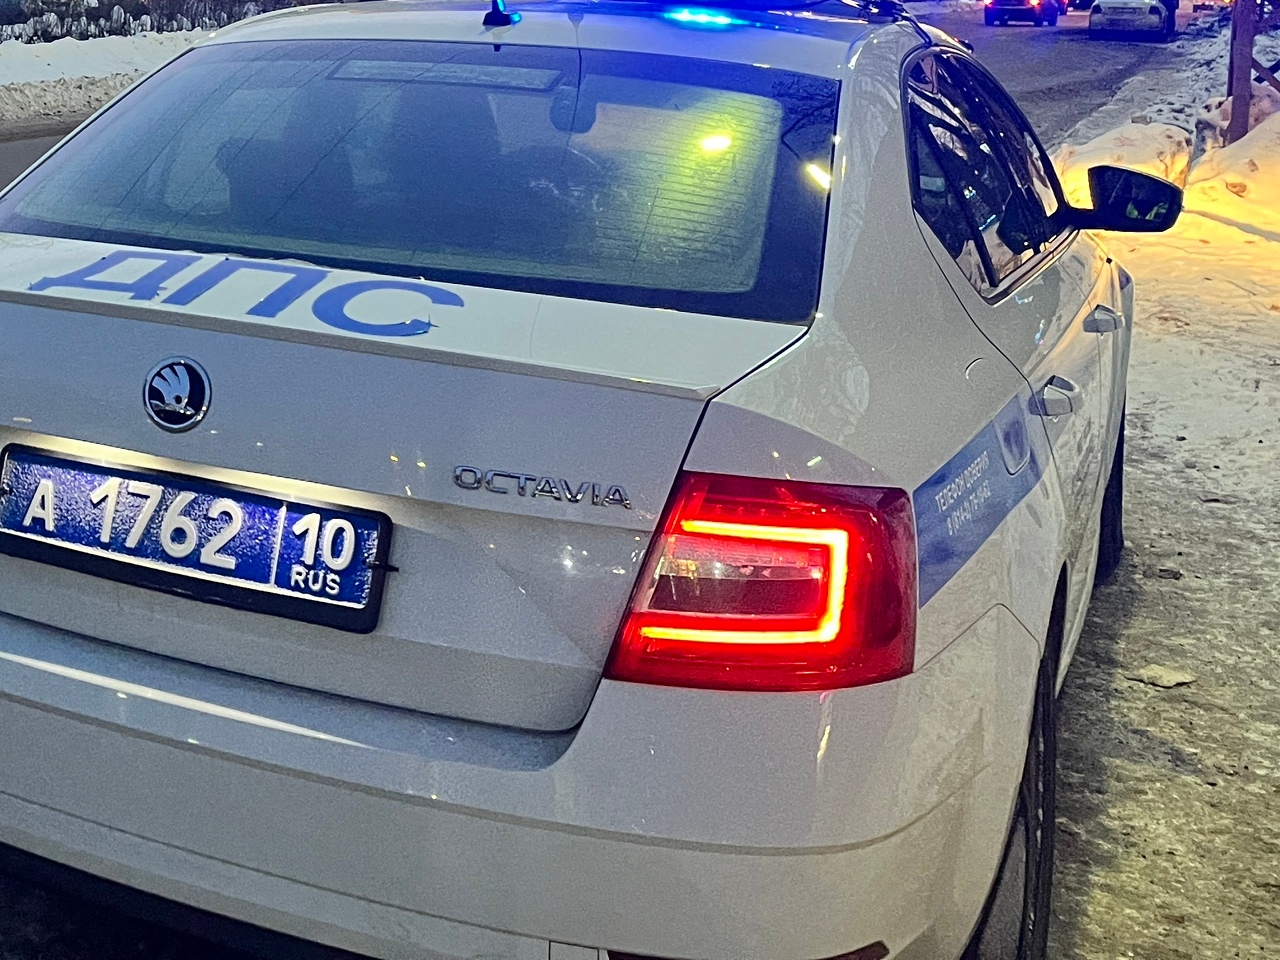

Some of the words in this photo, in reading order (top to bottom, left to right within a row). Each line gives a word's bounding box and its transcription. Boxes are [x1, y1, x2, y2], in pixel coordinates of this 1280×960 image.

[29, 250, 464, 337] ДПС
[453, 465, 632, 510] OCTAVIA
[89, 476, 244, 570] 1762
[292, 513, 356, 571] 10
[290, 565, 341, 597] RUS
